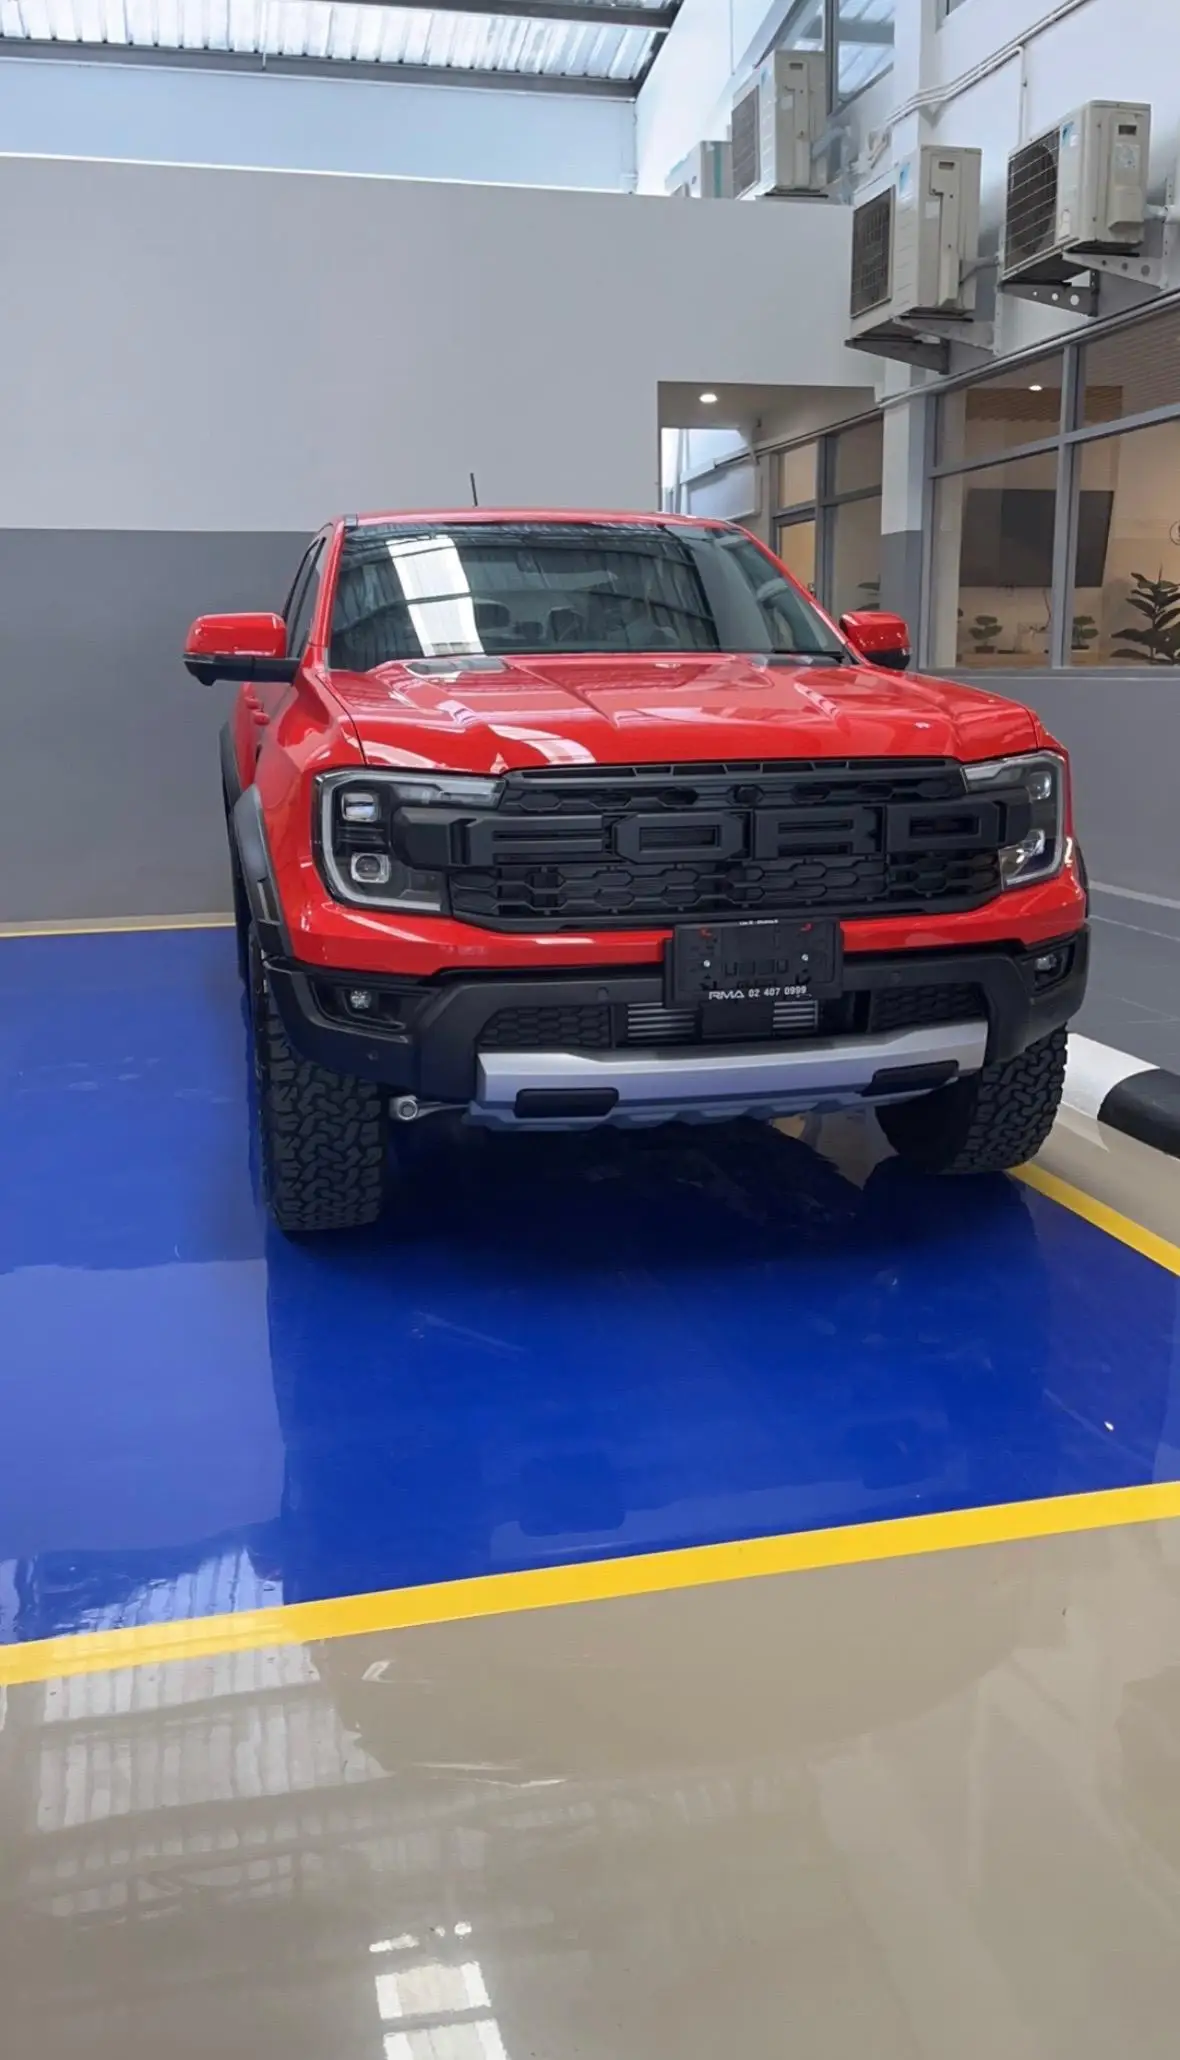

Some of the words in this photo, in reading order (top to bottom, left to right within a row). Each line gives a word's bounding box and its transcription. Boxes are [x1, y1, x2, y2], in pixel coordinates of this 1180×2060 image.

[468, 802, 1001, 866] FORD
[708, 990, 745, 1000] RMA
[748, 988, 760, 998] 02
[763, 987, 781, 996] 407
[784, 985, 807, 995] 0999
